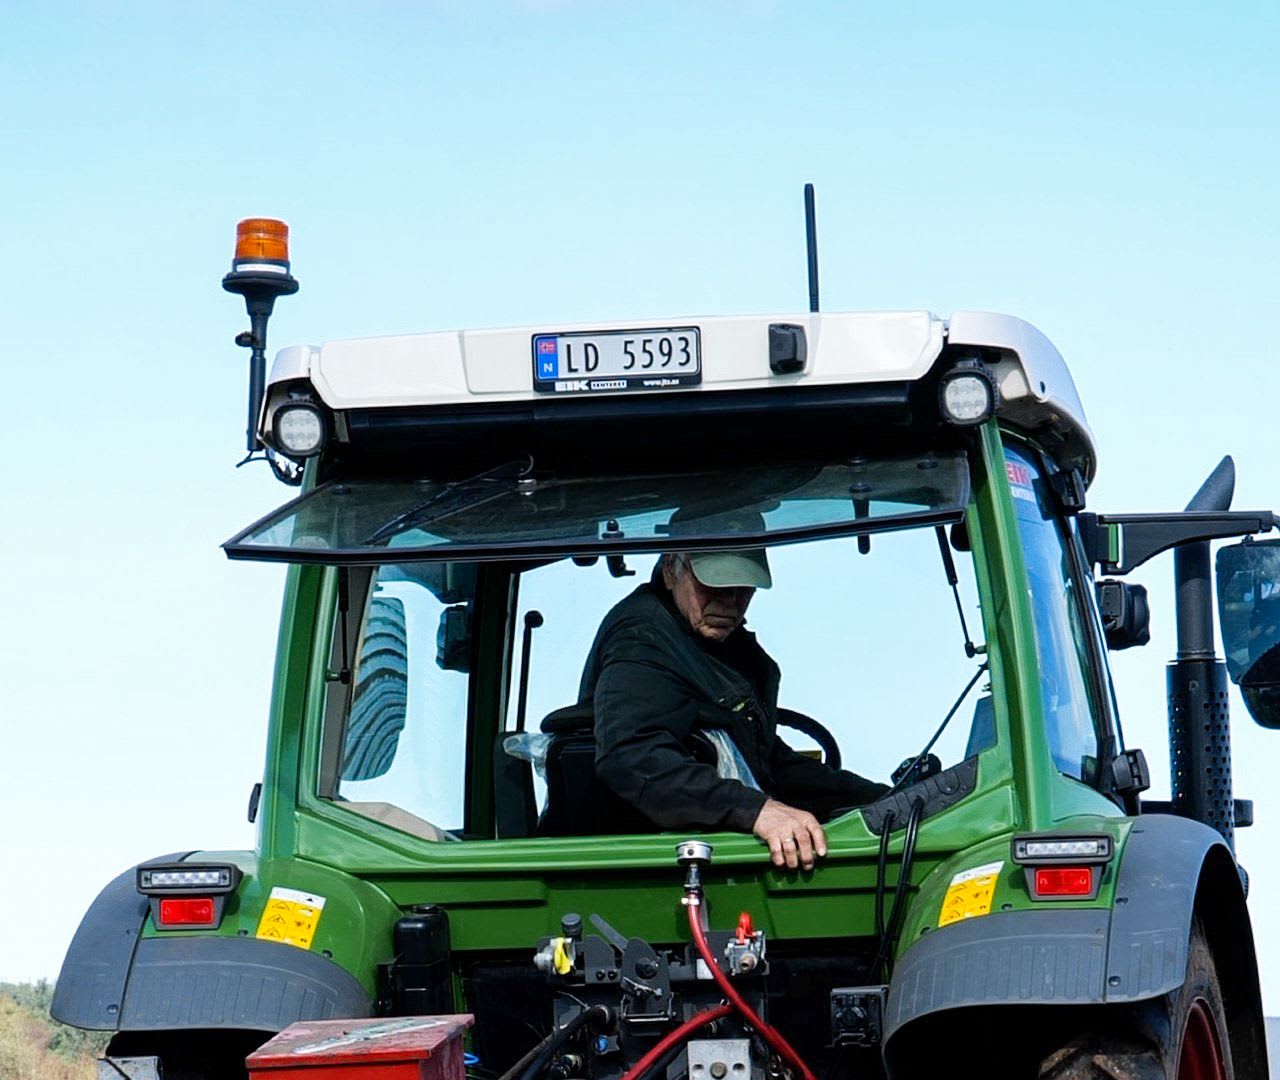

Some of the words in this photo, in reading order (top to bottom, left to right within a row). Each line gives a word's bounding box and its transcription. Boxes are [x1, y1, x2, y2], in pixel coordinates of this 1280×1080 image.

[566, 343, 599, 373] LD
[623, 336, 691, 370] 5593
[543, 362, 553, 373] N
